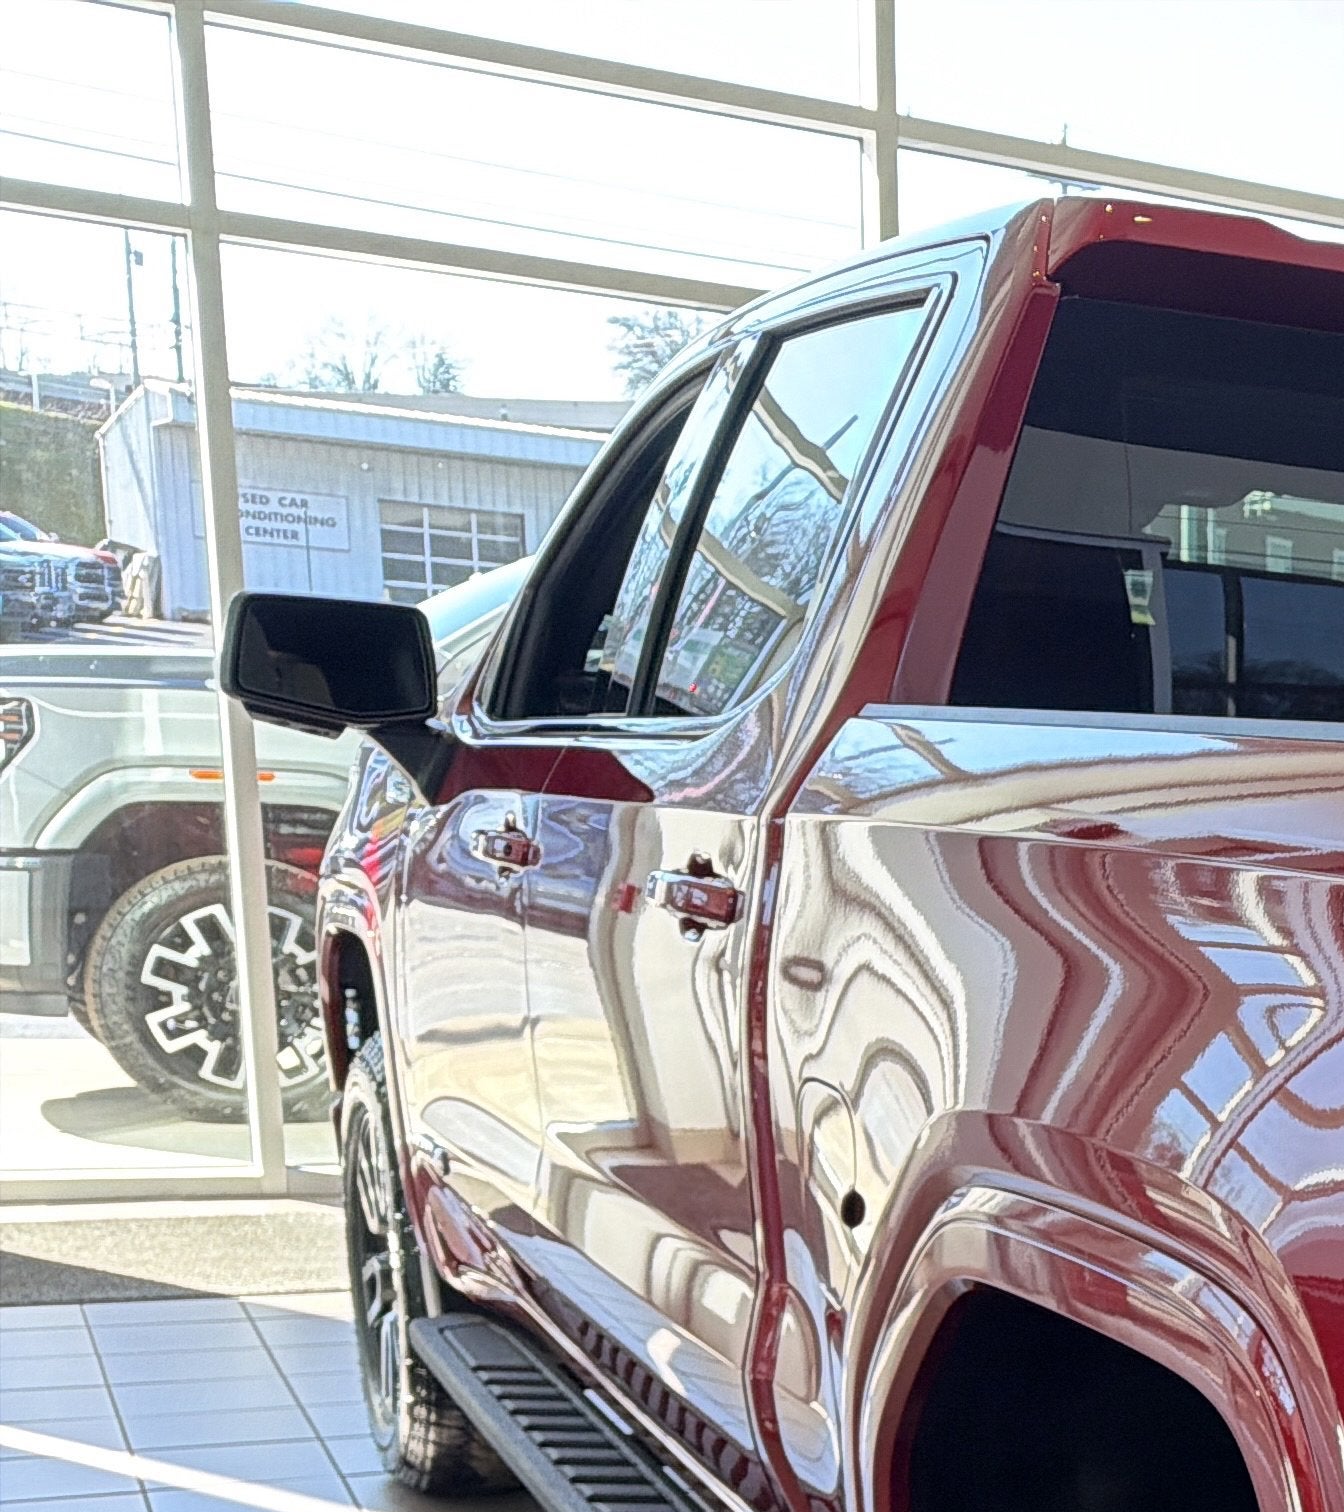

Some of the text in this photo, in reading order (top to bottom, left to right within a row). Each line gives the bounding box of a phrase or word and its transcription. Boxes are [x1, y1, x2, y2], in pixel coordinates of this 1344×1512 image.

[240, 492, 308, 509] SED CAR
[240, 508, 337, 528] NDITIONING
[244, 525, 299, 541] CENTER
